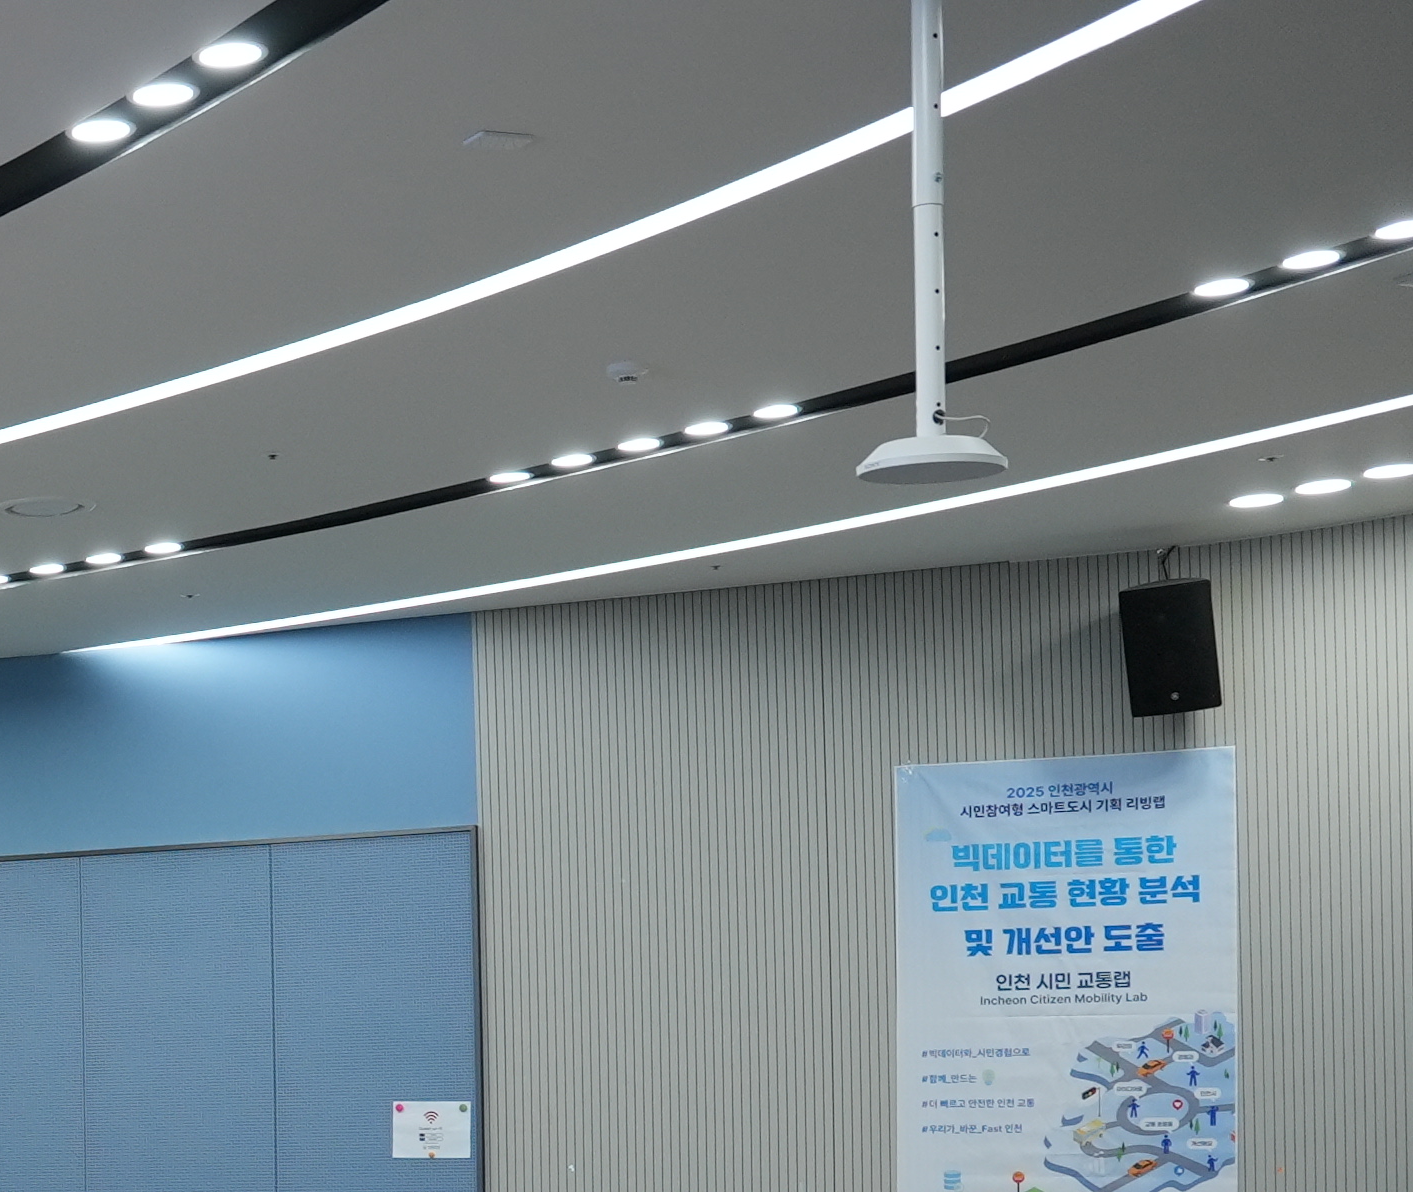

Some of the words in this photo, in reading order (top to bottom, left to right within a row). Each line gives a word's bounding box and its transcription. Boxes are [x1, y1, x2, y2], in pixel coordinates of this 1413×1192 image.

[1006, 786, 1044, 799] 2025
[1048, 781, 1114, 798] 인천광역시
[960, 803, 1024, 818] 시민참여형
[1027, 800, 1092, 815] 스마트도시
[1096, 797, 1122, 812] 기획
[1126, 795, 1166, 810] 리빙랩
[951, 839, 1104, 872] 빅데이터를
[1113, 834, 1178, 866] 통한
[929, 883, 989, 912] 인천
[998, 880, 1058, 910] 교통
[1067, 877, 1130, 908] 현황
[1138, 874, 1201, 905] 분석
[964, 929, 993, 957] 및
[1002, 926, 1095, 956] 개선안
[1102, 922, 1165, 952] 도출
[995, 972, 1031, 991] 인천
[1036, 972, 1071, 990] 시민
[1076, 970, 1131, 990] 교통랩
[979, 996, 1027, 1006] Incheon
[1030, 994, 1071, 1005] Citizen
[1074, 992, 1123, 1005] Mobility
[1125, 992, 1148, 1002] Lab
